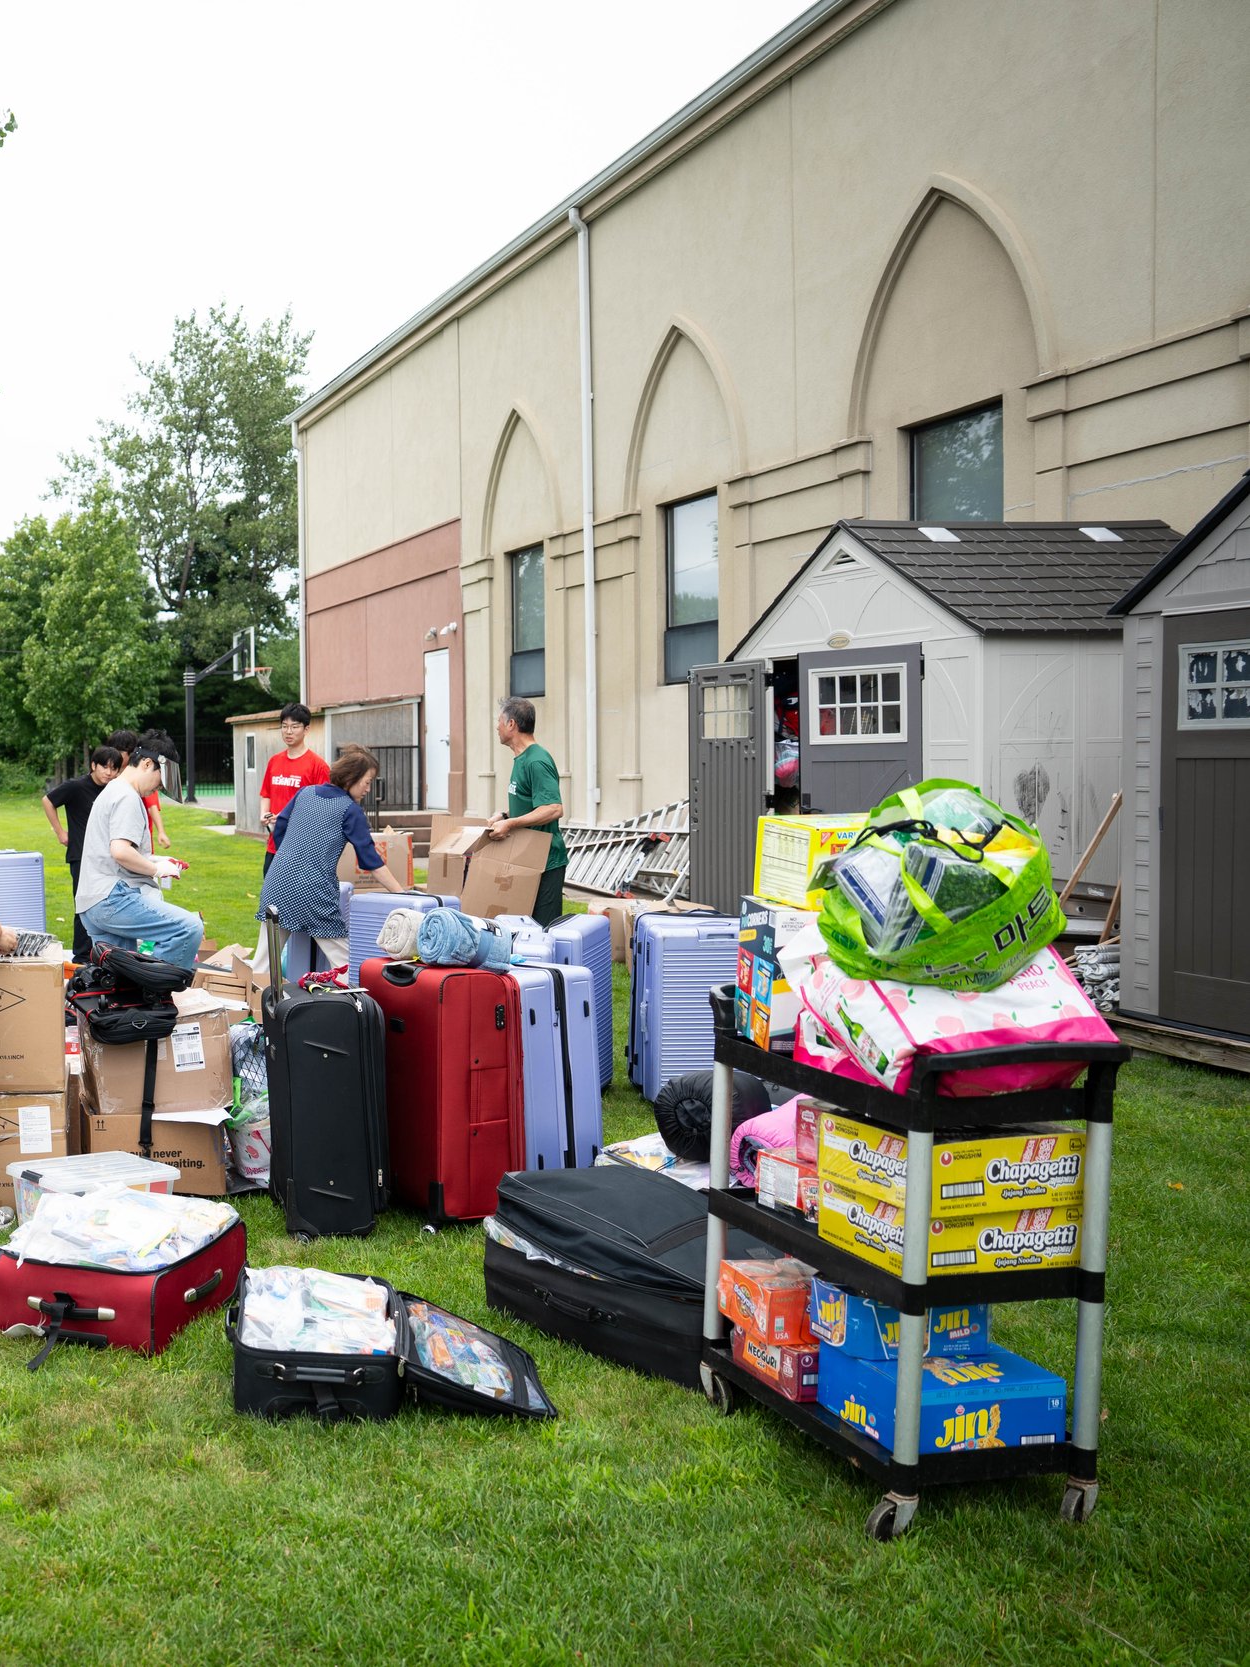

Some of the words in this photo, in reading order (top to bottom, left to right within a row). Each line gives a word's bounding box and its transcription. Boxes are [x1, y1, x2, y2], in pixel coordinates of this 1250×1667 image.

[1018, 978, 1048, 991] PEACH
[849, 1140, 908, 1175] Chapaget
[953, 1152, 982, 1161] NONGSHIM
[987, 1155, 1080, 1184] Chapagetti
[1023, 1186, 1047, 1195] Noodles
[944, 1221, 975, 1229] NONGSHIM
[979, 1225, 1077, 1254] Chapagetti
[1017, 1255, 1042, 1265] Noodles
[934, 1308, 970, 1334] Jin
[775, 1332, 788, 1340] USA
[949, 1328, 970, 1340] MILD
[748, 1342, 777, 1369] NEOGURI
[935, 1408, 990, 1448] Jin
